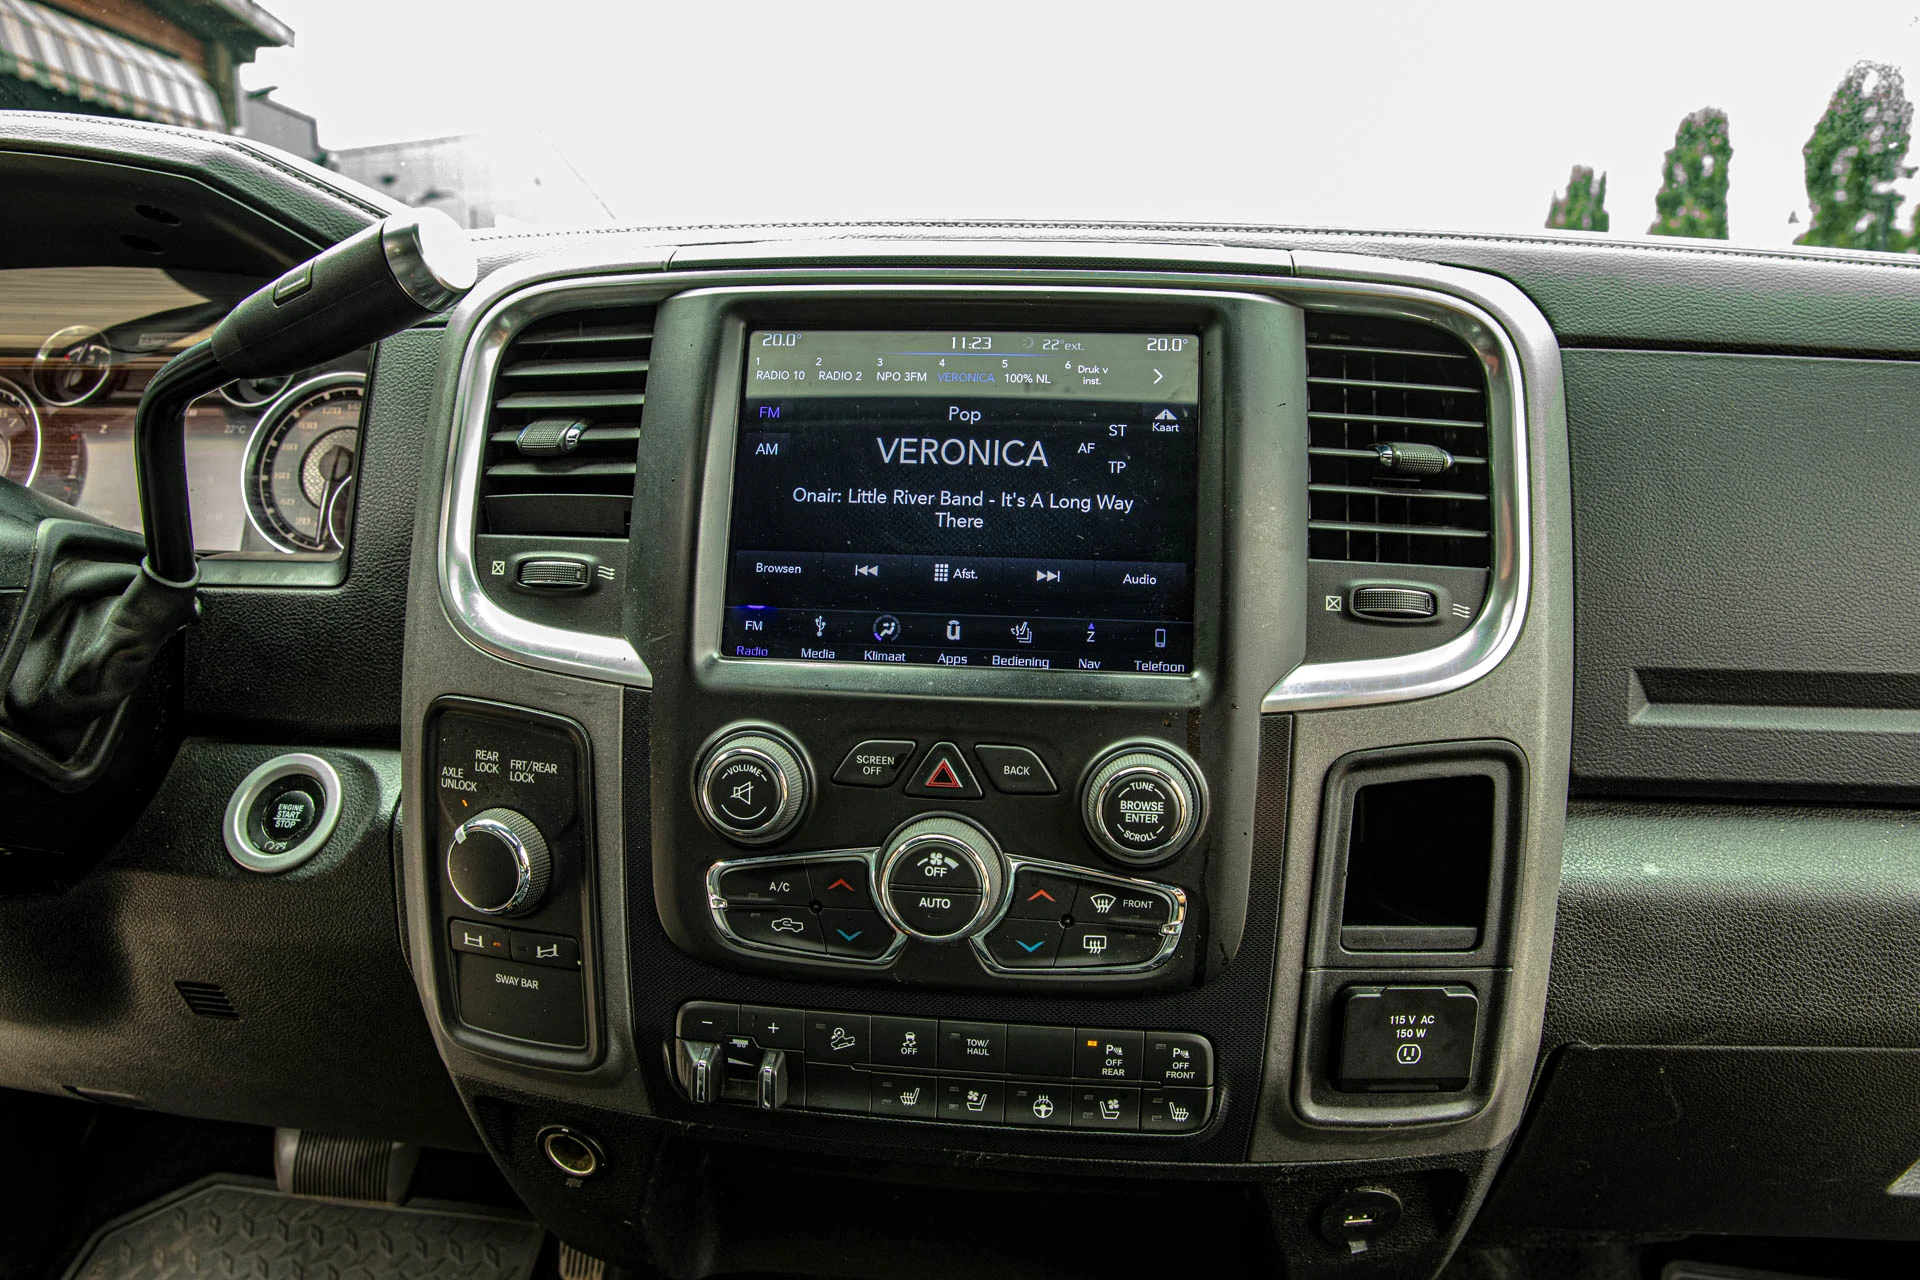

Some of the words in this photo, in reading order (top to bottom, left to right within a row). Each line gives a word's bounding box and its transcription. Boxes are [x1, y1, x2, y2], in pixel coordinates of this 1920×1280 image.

[762, 333, 802, 347] 20.0°
[951, 336, 992, 350] 11:23
[1147, 337, 1188, 351] 20.0°
[755, 357, 760, 365] 1
[815, 357, 822, 366] 2
[877, 358, 884, 367] 3
[939, 358, 946, 367] 4
[1002, 359, 1009, 368] 5
[1065, 361, 1072, 370] 6
[756, 370, 790, 380] RADIO
[794, 371, 805, 380] 10
[1078, 365, 1100, 374] Druk
[818, 371, 853, 381] RADIO
[856, 371, 862, 381] 2
[876, 372, 901, 382] NPO
[904, 372, 927, 382] 3FM
[937, 372, 995, 383] VERONICA
[1004, 373, 1033, 383] 100%
[1036, 374, 1051, 384] NL
[1083, 376, 1102, 385] inst.
[759, 406, 781, 419] FM
[949, 406, 981, 424] Pop
[1108, 424, 1127, 437] ST
[1152, 422, 1180, 432] Kaart
[755, 443, 779, 455] AM
[876, 437, 1049, 467] VERONICA
[1077, 442, 1095, 454] AF
[1108, 461, 1127, 474] TP
[793, 487, 842, 503] Onair:
[848, 488, 887, 504] Little
[893, 489, 935, 505] River
[940, 490, 984, 507] Band
[1001, 491, 1026, 508] It's
[1030, 492, 1044, 508] A
[1050, 493, 1091, 513] Long
[1096, 494, 1134, 514] Way
[935, 512, 984, 528] There
[755, 562, 802, 574] Browsen
[953, 568, 978, 580] Afst.
[1122, 574, 1157, 585] Audio
[745, 620, 763, 631] FM
[736, 645, 768, 657] Radio
[801, 648, 835, 660] Media
[864, 650, 906, 662] Klimaat
[937, 653, 968, 666] Apps
[992, 655, 1050, 669] Bediening
[1078, 658, 1101, 669] Nav
[1134, 660, 1185, 673] Telefoon
[475, 749, 499, 762] REAR
[856, 754, 895, 765] SCREEN
[442, 766, 464, 779] AXLE
[475, 761, 499, 774] LOCK
[510, 759, 558, 775] FRT/REAR
[726, 764, 763, 777] VOLUME
[862, 766, 882, 775] OFF
[1003, 765, 1030, 776] BACK
[509, 770, 535, 784] LOCK
[441, 777, 477, 792] UNLOCK
[1130, 781, 1155, 792] TUNE
[278, 803, 305, 812] ENGINE
[1120, 800, 1164, 812] BROWSE
[276, 811, 301, 819] START
[1125, 813, 1159, 824] ENTER
[274, 820, 296, 828] STOP
[1123, 830, 1157, 842] SCROLL
[924, 866, 947, 877] OFF
[769, 881, 790, 892] A/C
[919, 898, 951, 909] AUTO
[1123, 899, 1154, 909] FRONT
[495, 973, 519, 987] SWAY
[521, 976, 539, 990] BAR
[1389, 1015, 1406, 1025] 115
[1409, 1015, 1416, 1025] V
[1420, 1015, 1435, 1024] AC
[1395, 1029, 1413, 1038] 150
[1416, 1029, 1427, 1038] W
[966, 1038, 989, 1048] TOW/
[901, 1047, 917, 1055] OFF
[967, 1047, 989, 1056] HAUL
[1105, 1058, 1123, 1067] OFF
[1172, 1061, 1189, 1070] OFF
[1102, 1067, 1125, 1077] REAR
[1165, 1070, 1195, 1079] FRONT
